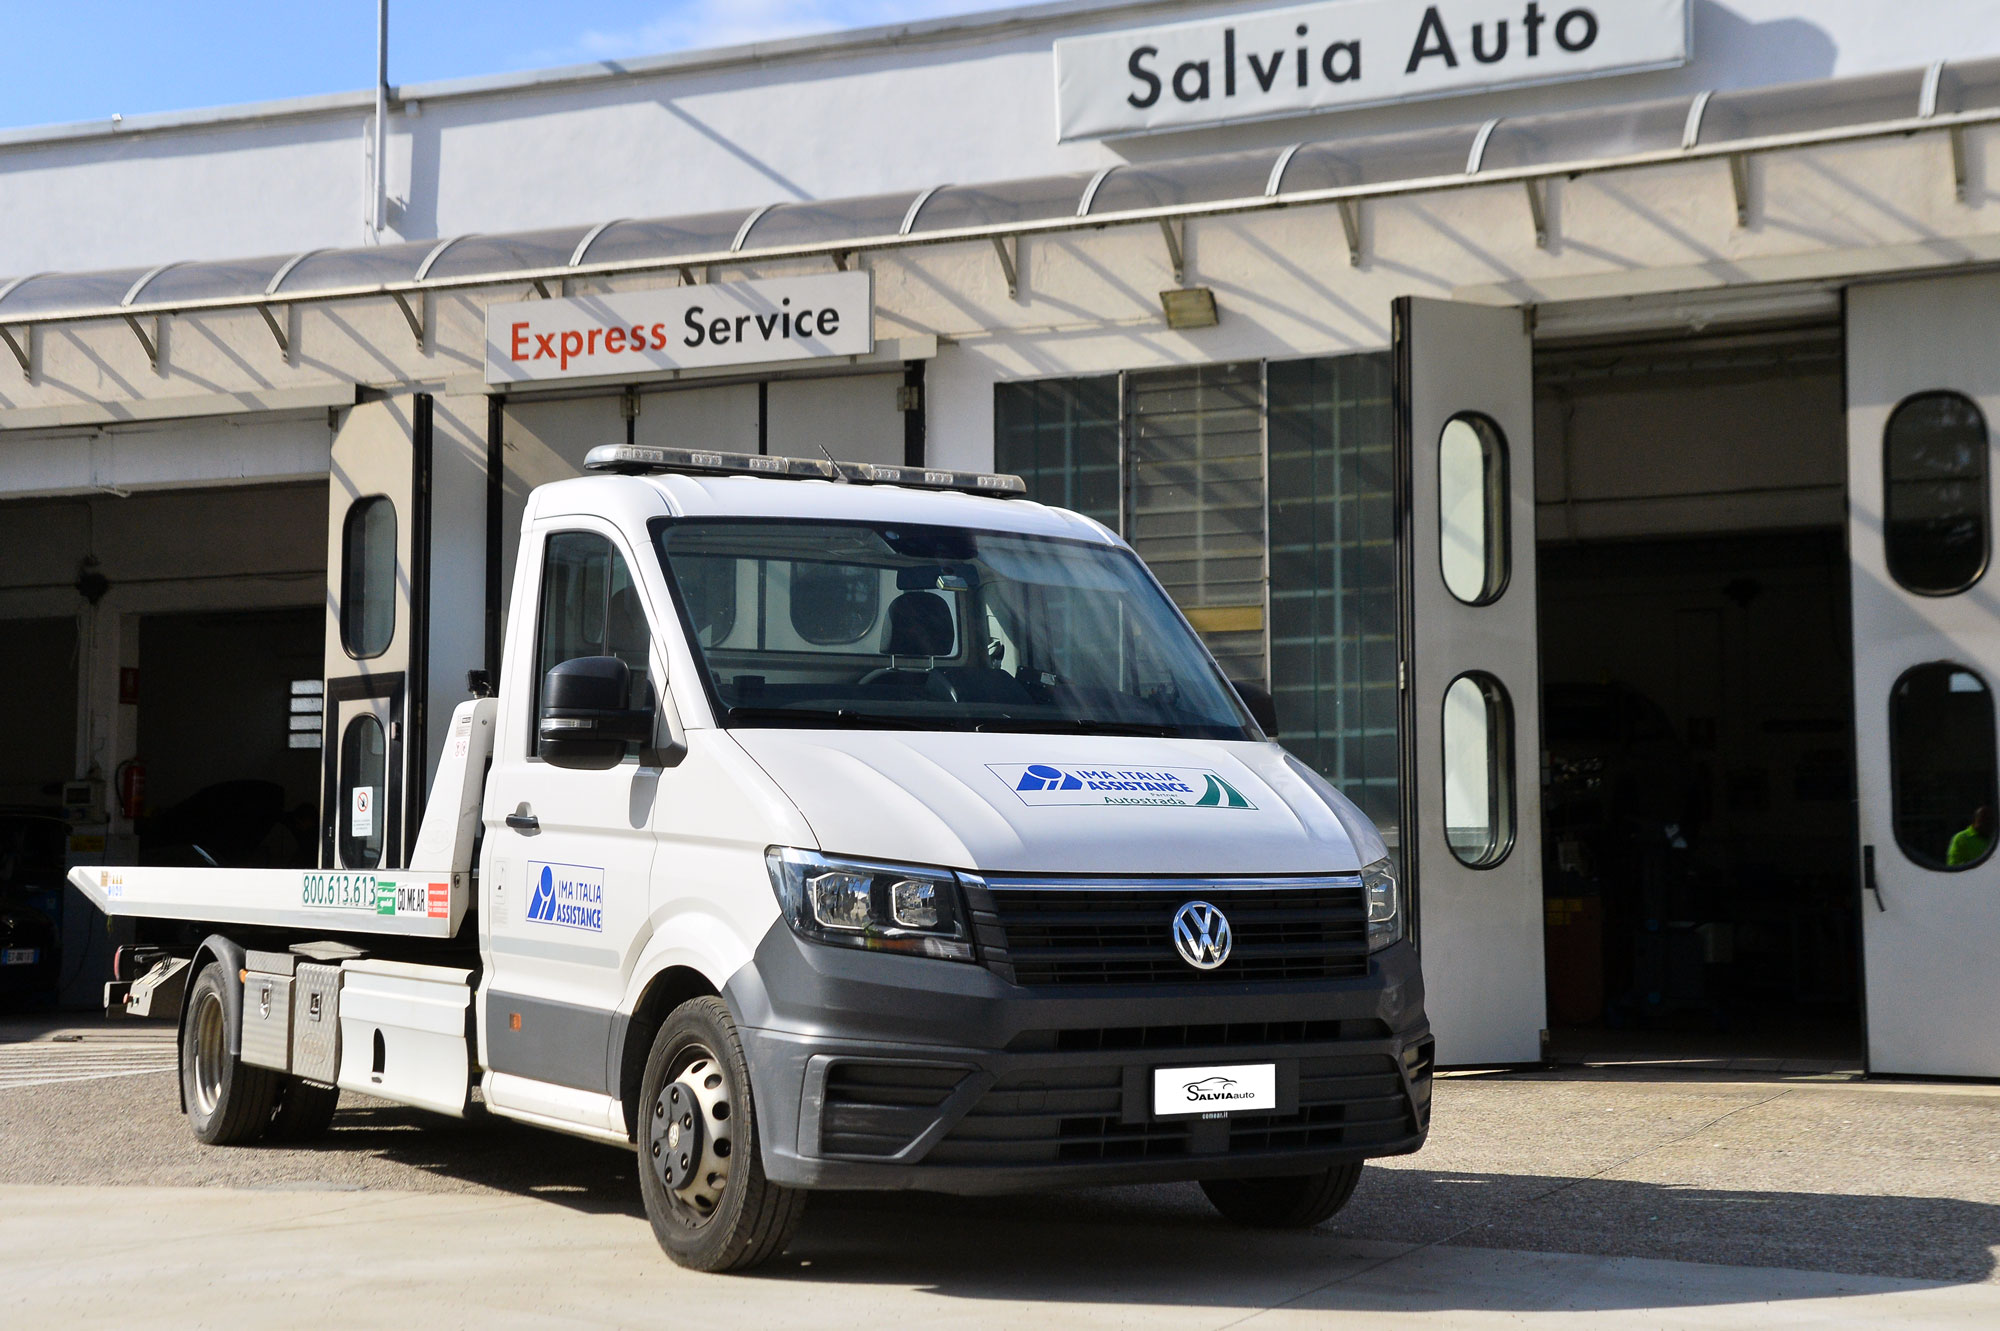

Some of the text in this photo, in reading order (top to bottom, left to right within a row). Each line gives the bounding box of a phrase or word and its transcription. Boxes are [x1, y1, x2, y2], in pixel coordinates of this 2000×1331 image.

[1126, 1, 1600, 109] Salvia Auto
[511, 298, 840, 370] Express Service
[1076, 770, 1181, 782] IMA ITALIA
[1087, 780, 1194, 793] ASSISTANCE
[1104, 796, 1186, 805] Autostrada
[303, 875, 376, 905] 800.613.613
[558, 880, 602, 904] IMA ITALIA
[556, 903, 601, 929] ASSISTANCE
